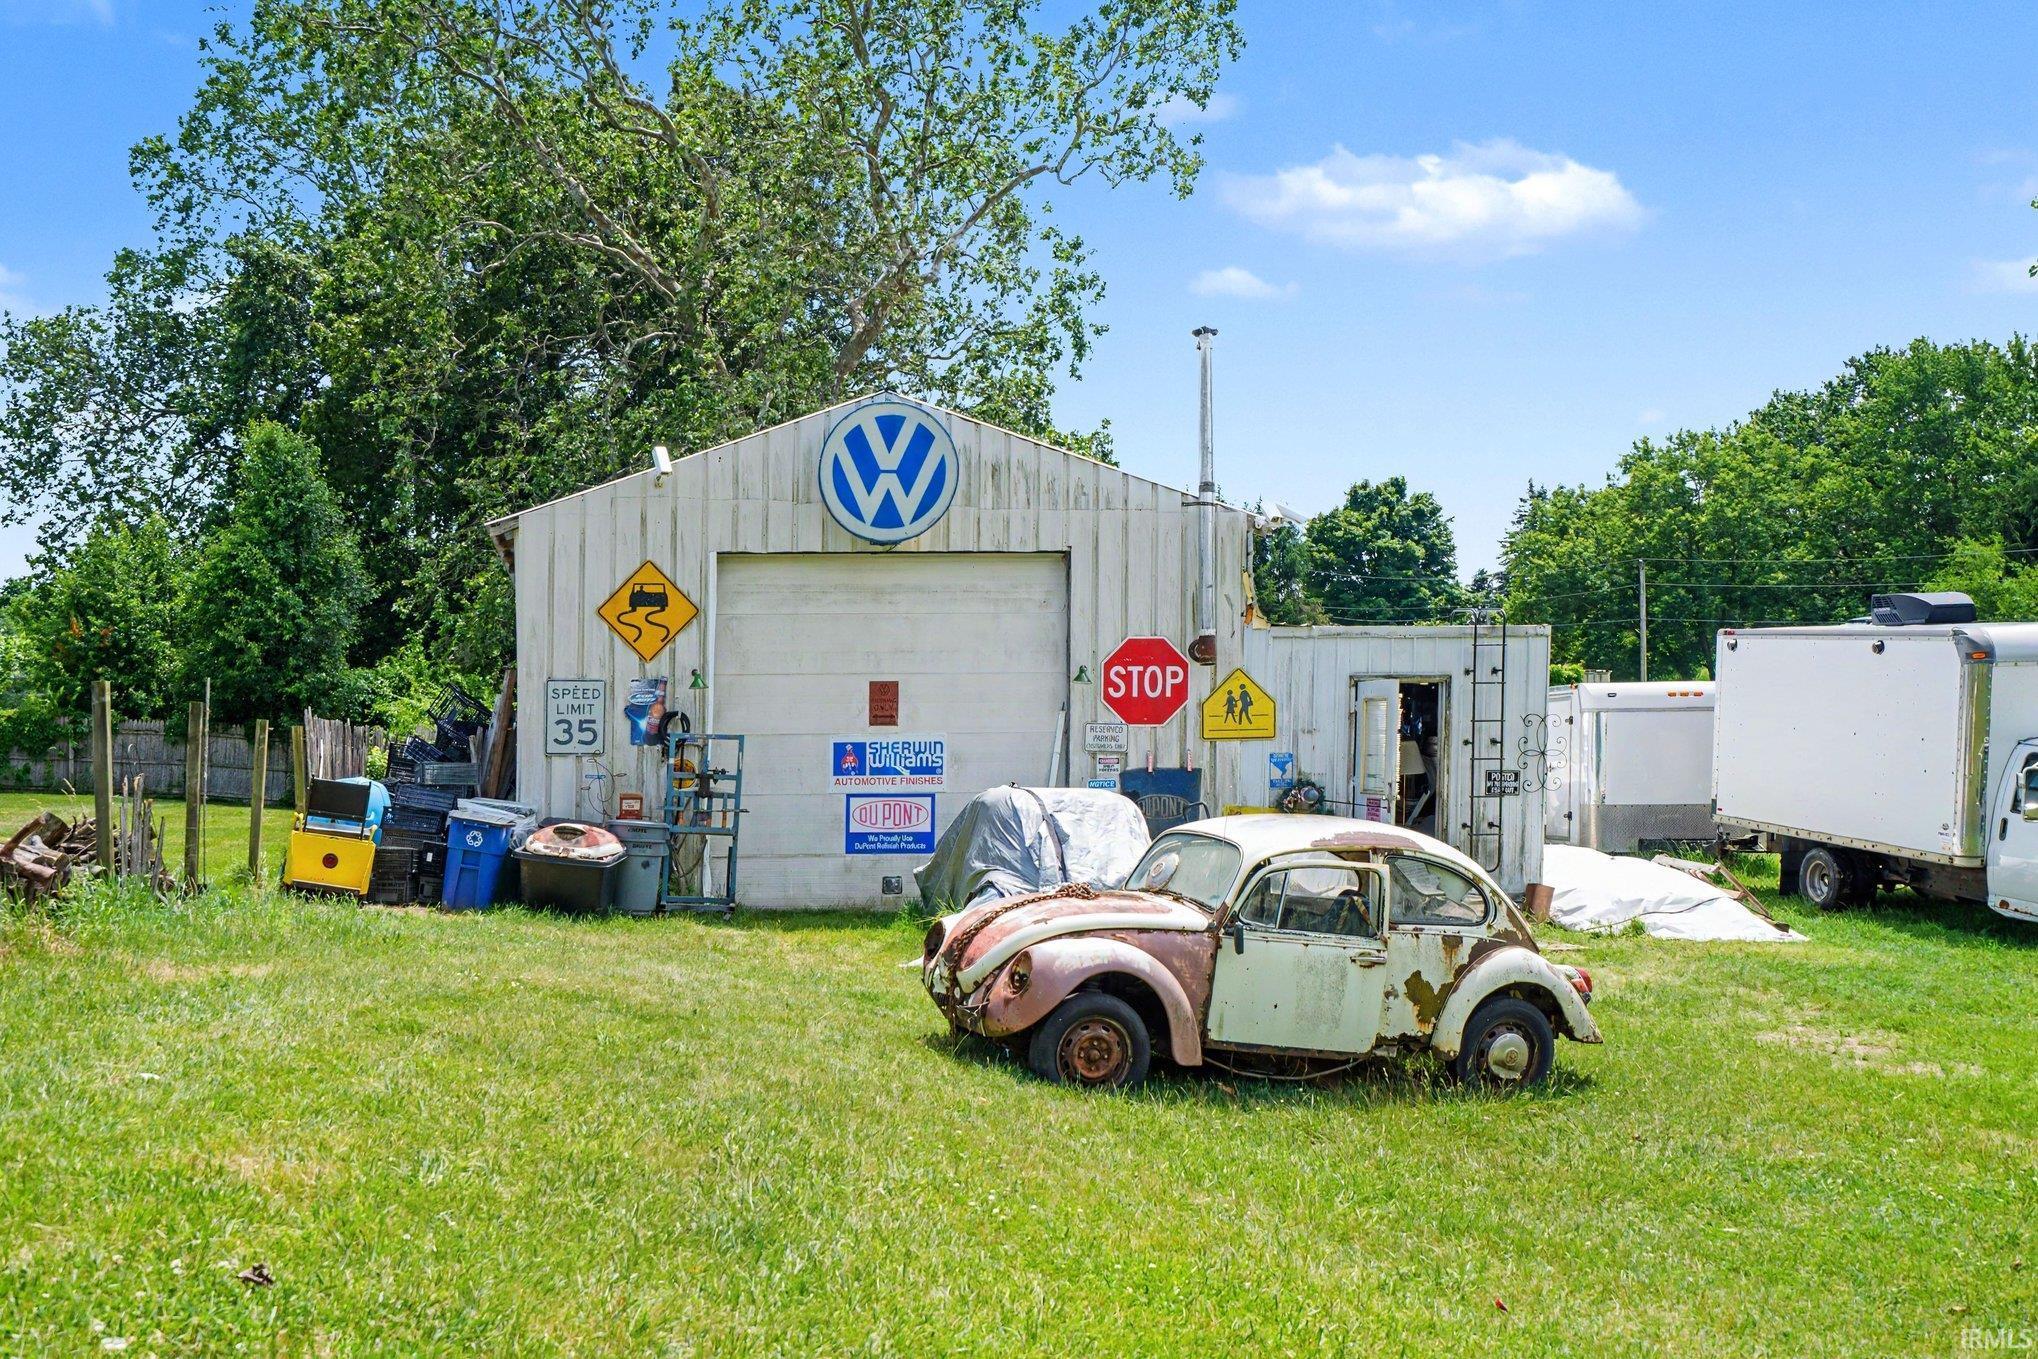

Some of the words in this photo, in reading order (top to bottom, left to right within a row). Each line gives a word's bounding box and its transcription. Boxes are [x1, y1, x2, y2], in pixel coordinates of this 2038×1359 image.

[828, 410, 951, 533] VW
[1107, 665, 1184, 698] STOP
[551, 688, 601, 699] SPEED
[556, 703, 595, 715] LIMIT
[553, 718, 598, 746] 35
[1089, 725, 1123, 733] RESERVED
[868, 741, 943, 754] SHERWIN
[834, 777, 897, 786] AUTOMOTIVE
[900, 776, 943, 785] FINISHES
[1089, 780, 1115, 788] NOTICE
[879, 834, 901, 843] Proudly
